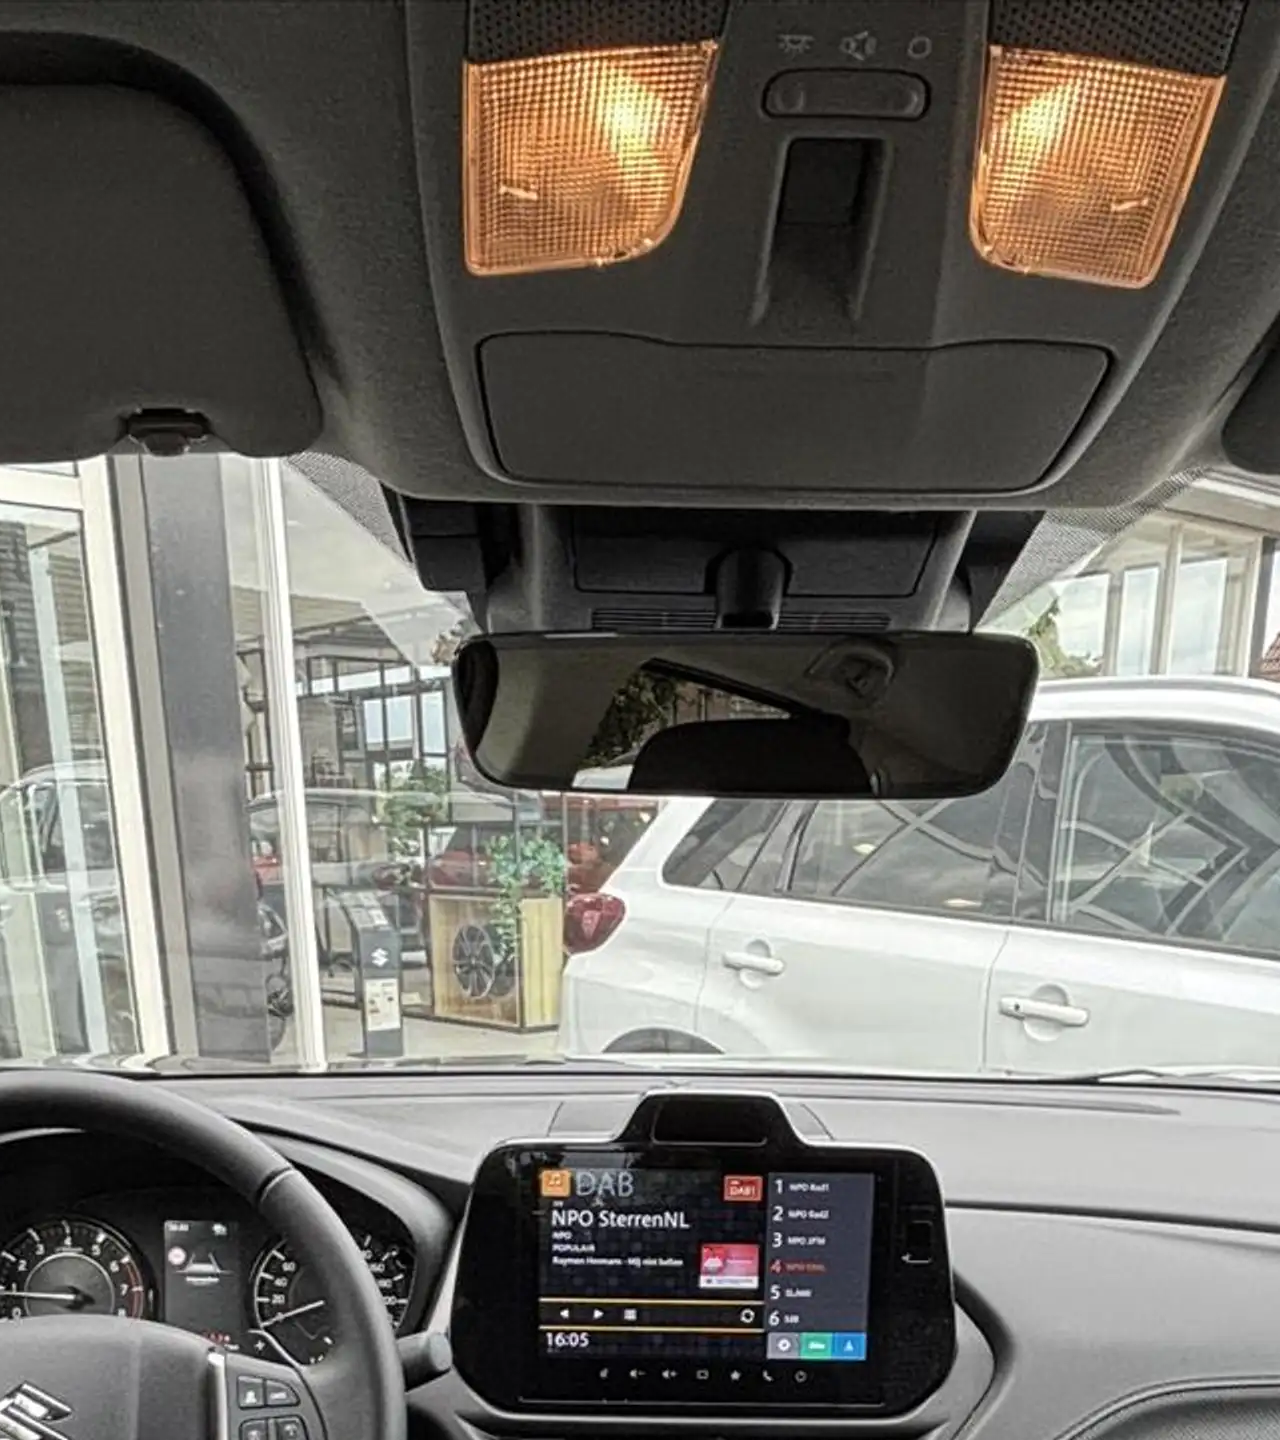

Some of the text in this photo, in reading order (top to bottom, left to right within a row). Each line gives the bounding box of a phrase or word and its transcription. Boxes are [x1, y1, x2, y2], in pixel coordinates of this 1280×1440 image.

[575, 1171, 634, 1197] DAB
[775, 1179, 783, 1194] 1
[551, 1210, 690, 1229] NPO SterrenNL
[772, 1206, 783, 1221] 2
[552, 1231, 573, 1240] NPO
[772, 1232, 782, 1247] 3
[36, 1245, 45, 1255] 3
[92, 1245, 100, 1256] 5
[18, 1260, 27, 1271] 2
[110, 1261, 119, 1272] 6
[120, 1284, 128, 1295] 7
[770, 1285, 780, 1300] 5
[769, 1311, 780, 1326] 6
[546, 1332, 589, 1347] 16:05
